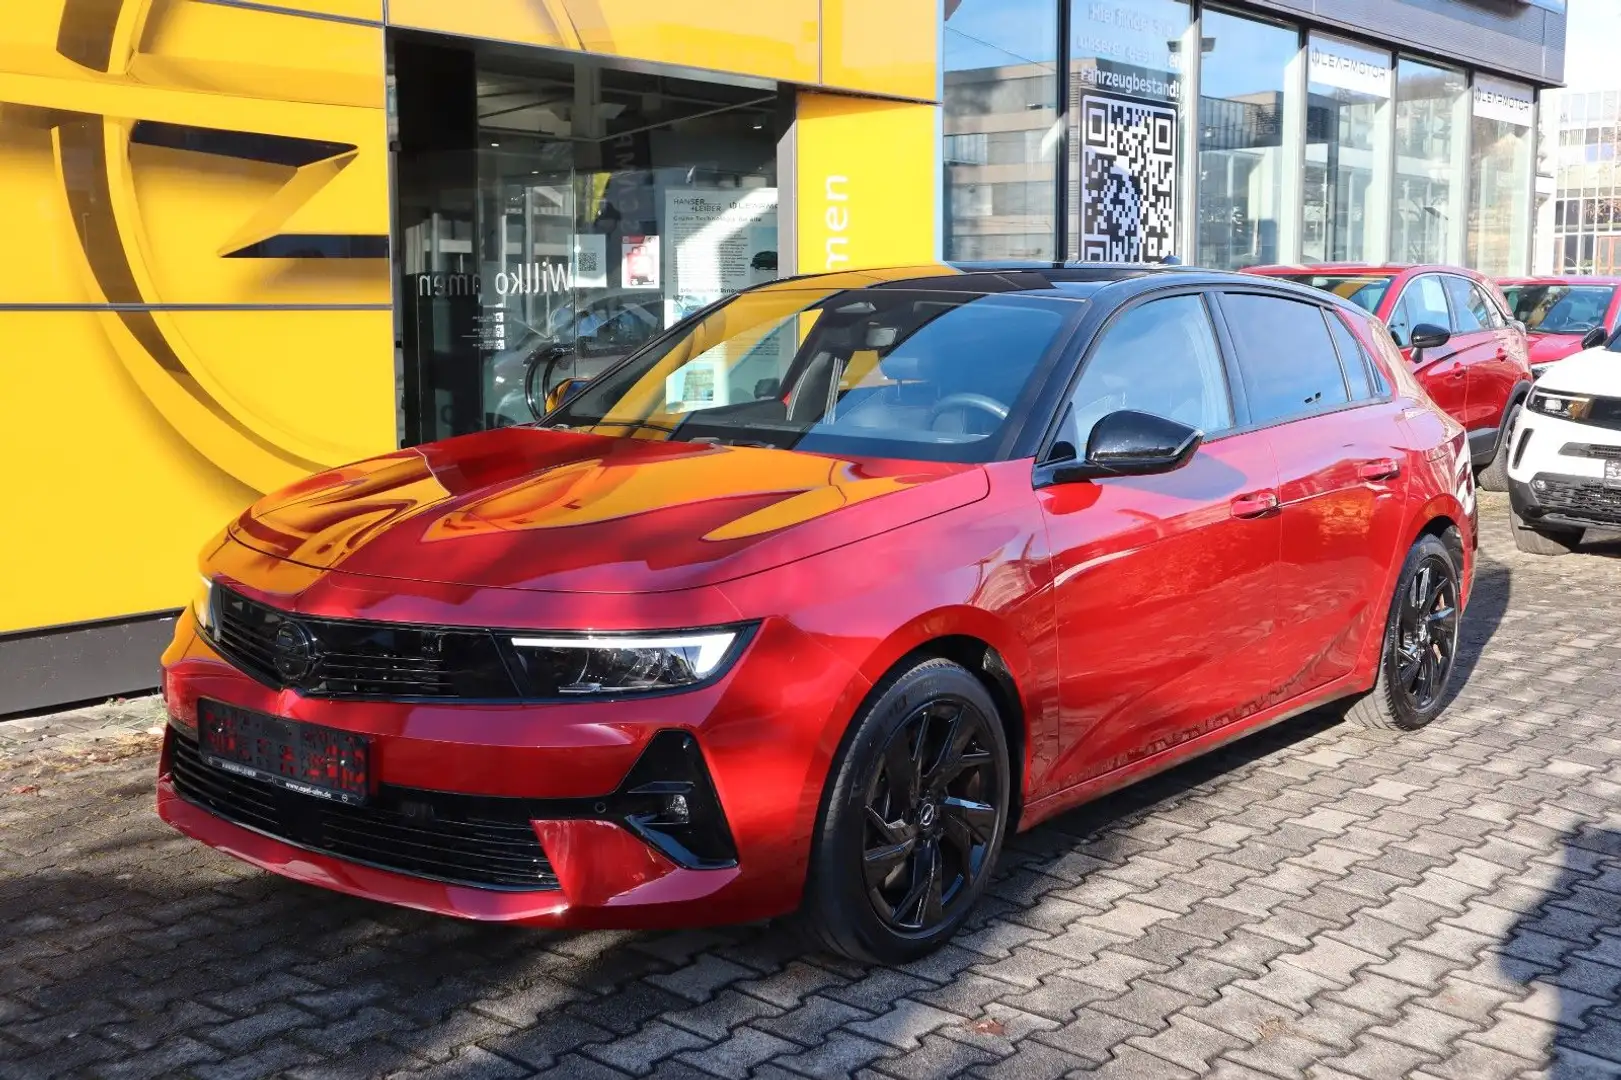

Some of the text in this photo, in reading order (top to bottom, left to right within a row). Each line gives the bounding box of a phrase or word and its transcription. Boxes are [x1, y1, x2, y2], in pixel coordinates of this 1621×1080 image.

[1321, 53, 1386, 79] LEAPMOTOR
[1081, 66, 1180, 98] Fahrzeugbestand!
[673, 198, 706, 206] HANSER
